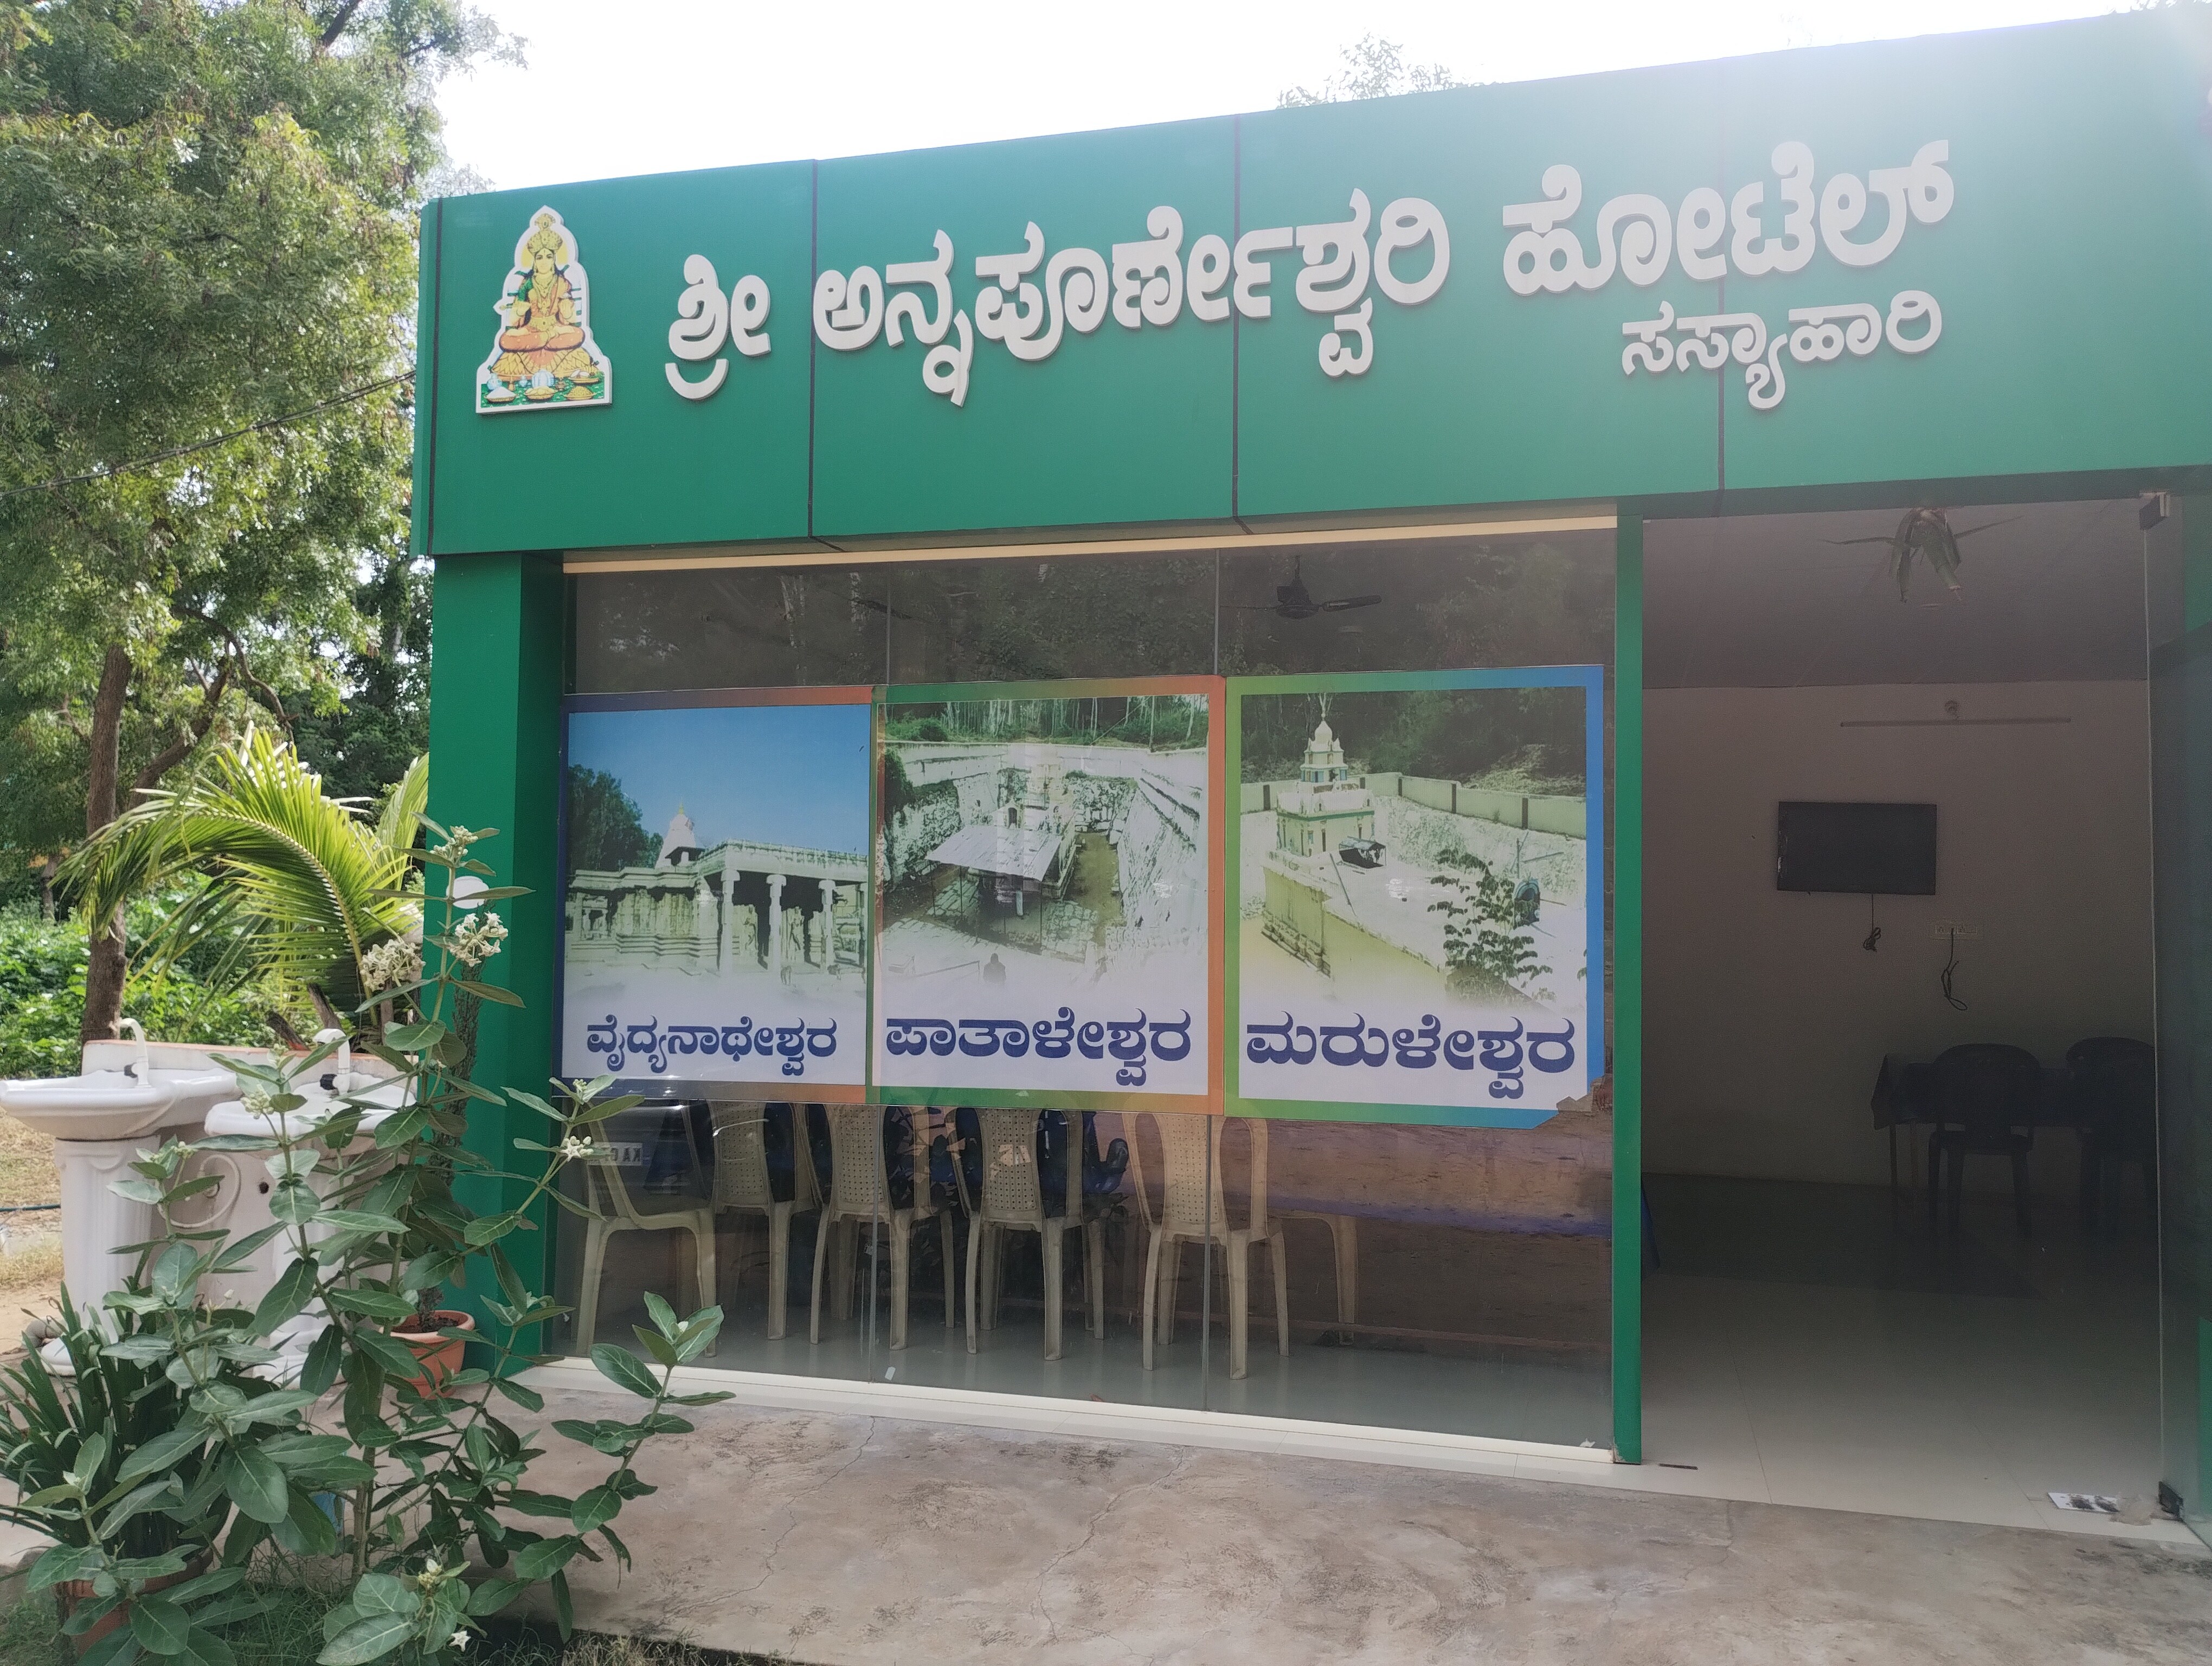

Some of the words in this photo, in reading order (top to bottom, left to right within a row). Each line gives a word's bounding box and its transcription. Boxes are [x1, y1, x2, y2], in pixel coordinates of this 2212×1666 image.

[665, 254, 771, 401] ಶ್ರೀ
[814, 187, 1450, 408] ಅನ್ನಪೂರ್ಣೇಶ್ವರಿ
[1502, 140, 1955, 297] ಹೋಟೆಲ್
[1622, 290, 1943, 411] ಸಸ್ಯಾಹಾರಿ
[587, 1014, 837, 1076] ವೈದ್ಯನಾಥೇಶ್ವರ
[886, 1007, 1192, 1086] ಪಾತಾಳೇಶ್ವರ
[1246, 1010, 1576, 1100] ಮರುಳೇಶ್ವರ
